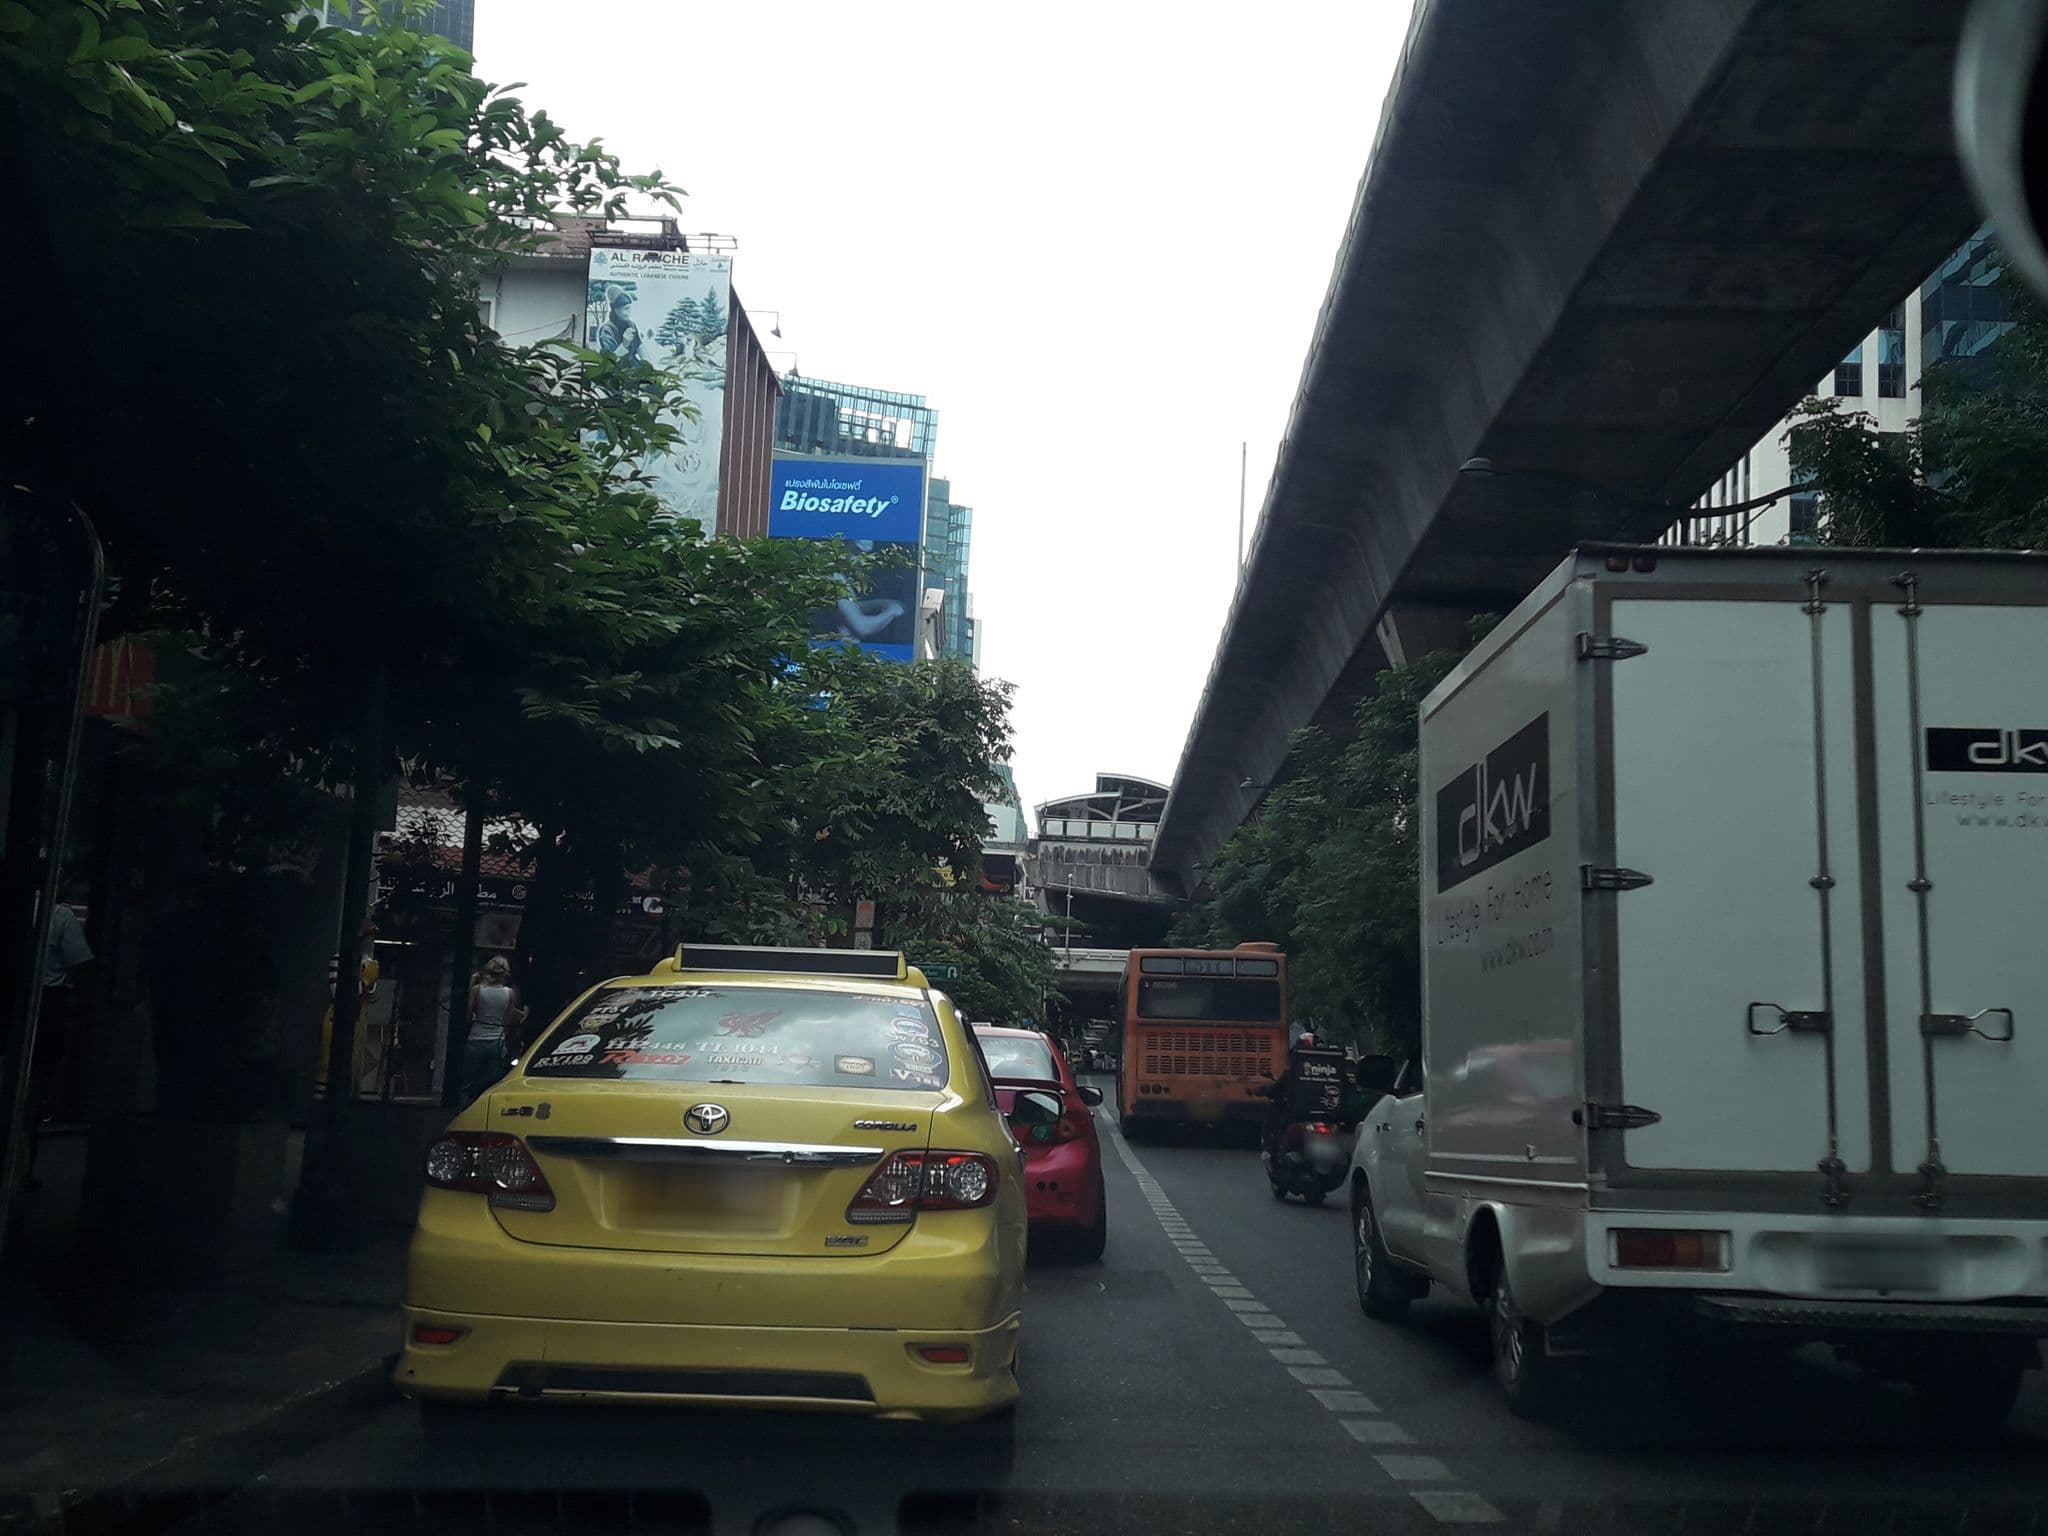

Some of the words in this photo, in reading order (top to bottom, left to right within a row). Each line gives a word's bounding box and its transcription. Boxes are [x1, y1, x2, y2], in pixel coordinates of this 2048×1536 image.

[610, 252, 627, 262] AL
[1967, 729, 2048, 765] dk
[1459, 761, 1537, 868] dkw
[854, 1119, 918, 1131] COROLLA
